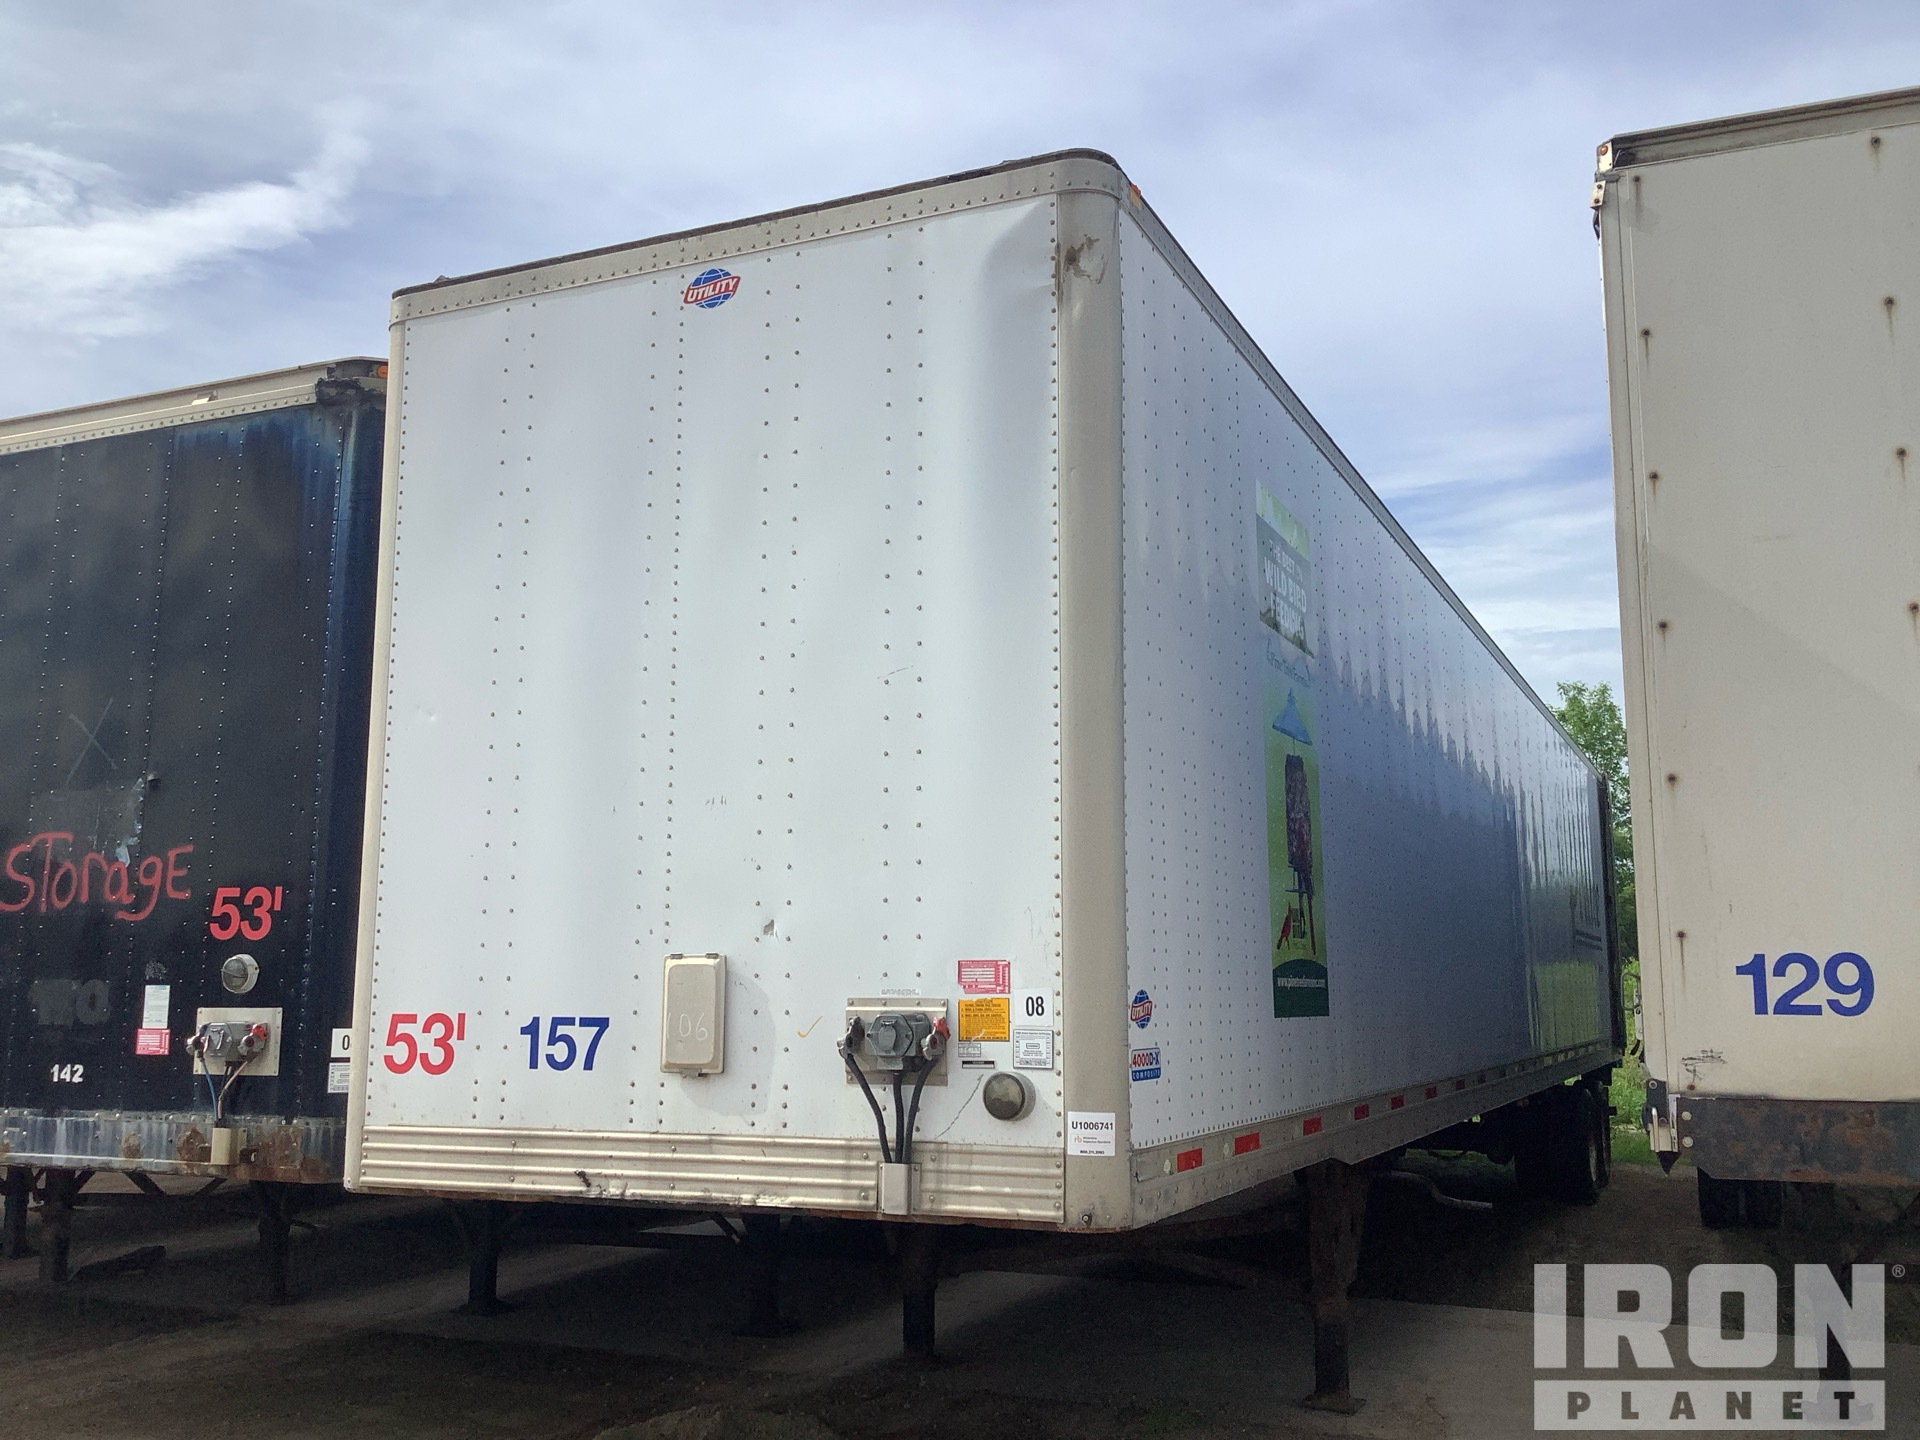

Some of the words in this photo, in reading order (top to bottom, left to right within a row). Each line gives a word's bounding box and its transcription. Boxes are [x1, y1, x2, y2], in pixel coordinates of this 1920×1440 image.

[687, 278, 738, 302] UTILITY
[1264, 556, 1287, 597] WILD
[1288, 577, 1307, 614] BIRD
[209, 886, 283, 941] 53'
[1735, 952, 1875, 1016] 129
[1026, 996, 1045, 1017] 08
[1131, 1003, 1152, 1020] UTILITY
[383, 1012, 466, 1075] 53'
[520, 1016, 610, 1071] 157
[51, 1063, 84, 1083] 142
[1132, 1068, 1161, 1080] COMPOSITE
[1071, 1121, 1113, 1130] U1006741
